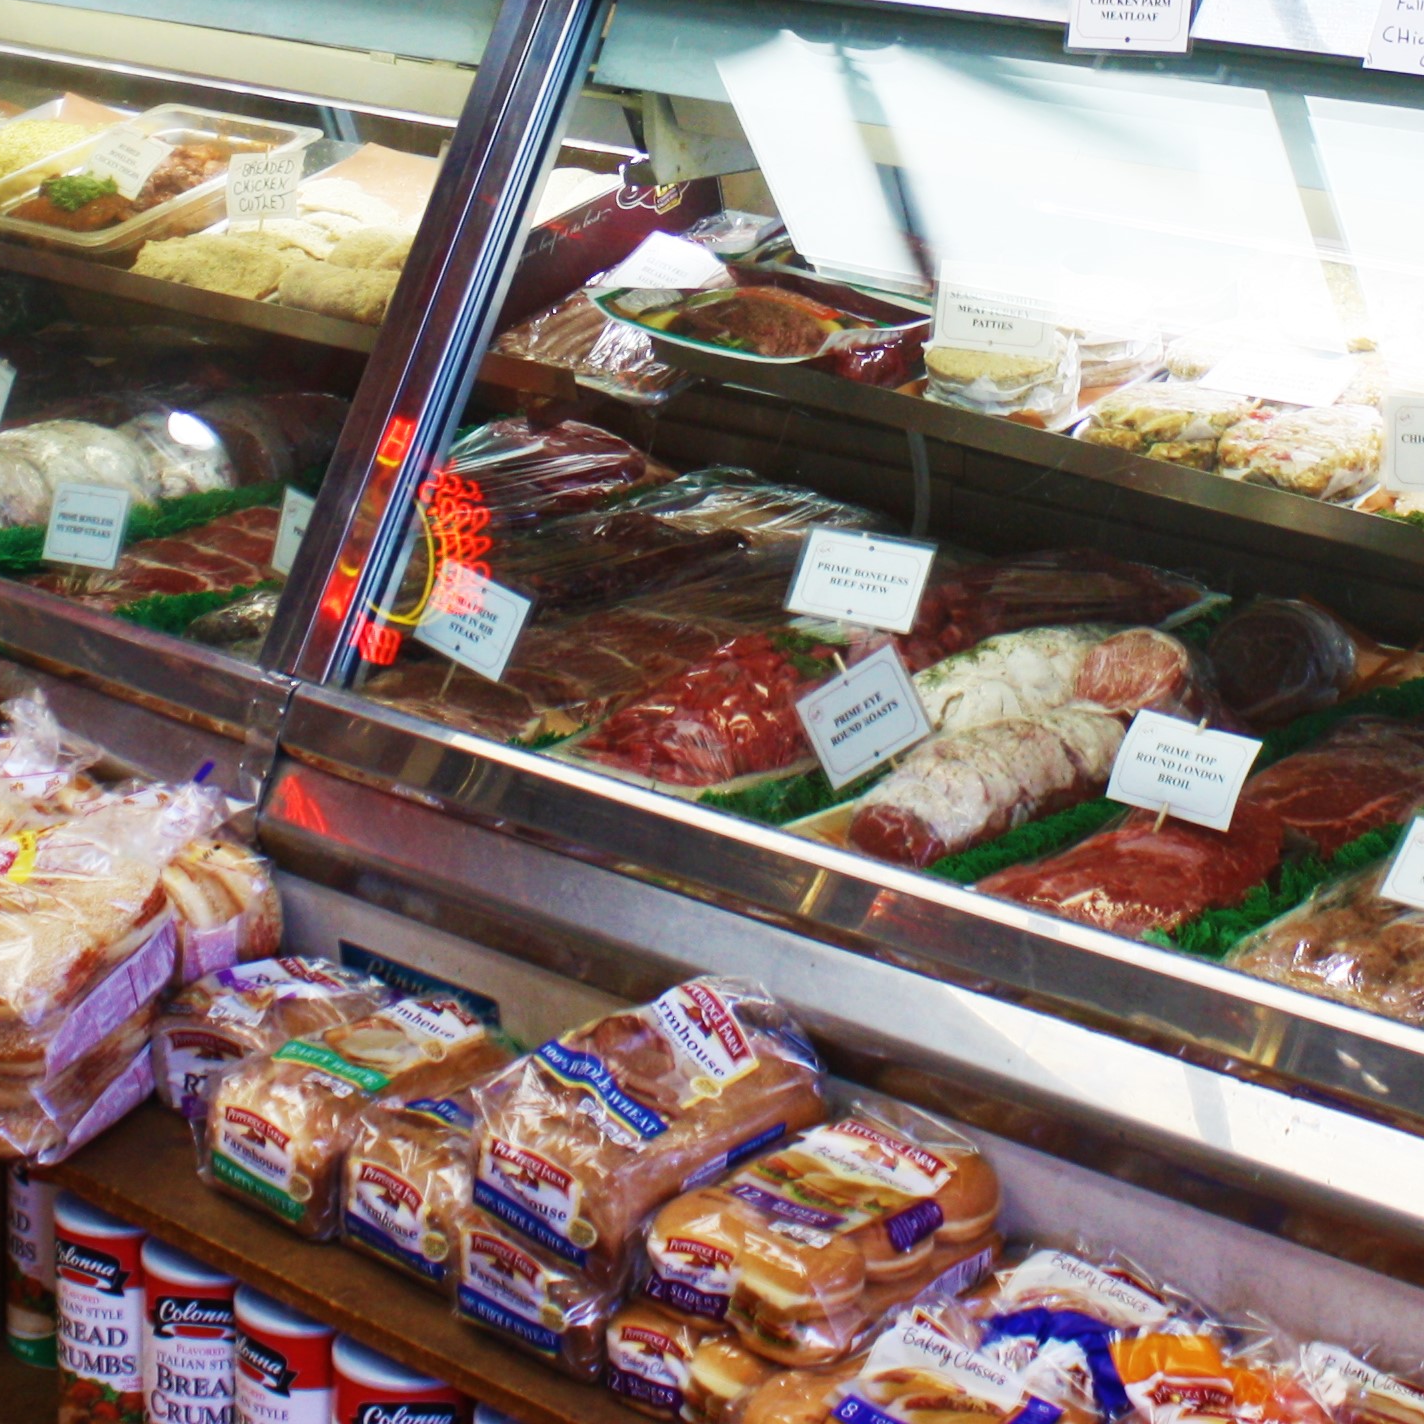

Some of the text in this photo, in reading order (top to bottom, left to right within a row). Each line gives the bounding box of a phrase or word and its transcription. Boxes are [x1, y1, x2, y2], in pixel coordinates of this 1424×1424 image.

[1101, 10, 1160, 23] MEATLOAF
[958, 304, 985, 316] MEAT
[972, 318, 1014, 330] PATTIES
[817, 561, 910, 588] PRIME BONELESS
[829, 576, 891, 595] BEEF STEW
[448, 622, 480, 644] STEAKS
[468, 616, 494, 637] IN RIB
[832, 691, 884, 727] PRIME EYE
[830, 701, 900, 749] ROUND ROASTS
[1156, 741, 1218, 766] PRIME TOP
[1135, 751, 1226, 785] ROUND LONDON
[1156, 771, 1192, 792] BROIL
[656, 997, 727, 1078] rmhouse
[715, 1023, 747, 1060] FARM
[570, 1056, 612, 1100] WHOLE
[608, 1091, 660, 1136] WHEAT
[228, 1108, 267, 1133] PEPPERIDGE
[222, 1130, 287, 1177] Farmhouse
[903, 1145, 937, 1172] FARM
[540, 1164, 567, 1189] FARM
[734, 1184, 763, 1201] 12
[669, 1239, 713, 1258] PEPPERIDGE
[645, 1275, 721, 1309] 12 SLIDERS
[1049, 1251, 1152, 1315] Bakery Classics
[93, 1305, 125, 1321] STYLE
[156, 1350, 215, 1371] ITALIAN
[176, 1342, 226, 1358] FLAVORED
[901, 1326, 1009, 1387] Bakery Classics
[251, 1402, 289, 1422] STYLE
[840, 1400, 859, 1419] 8
